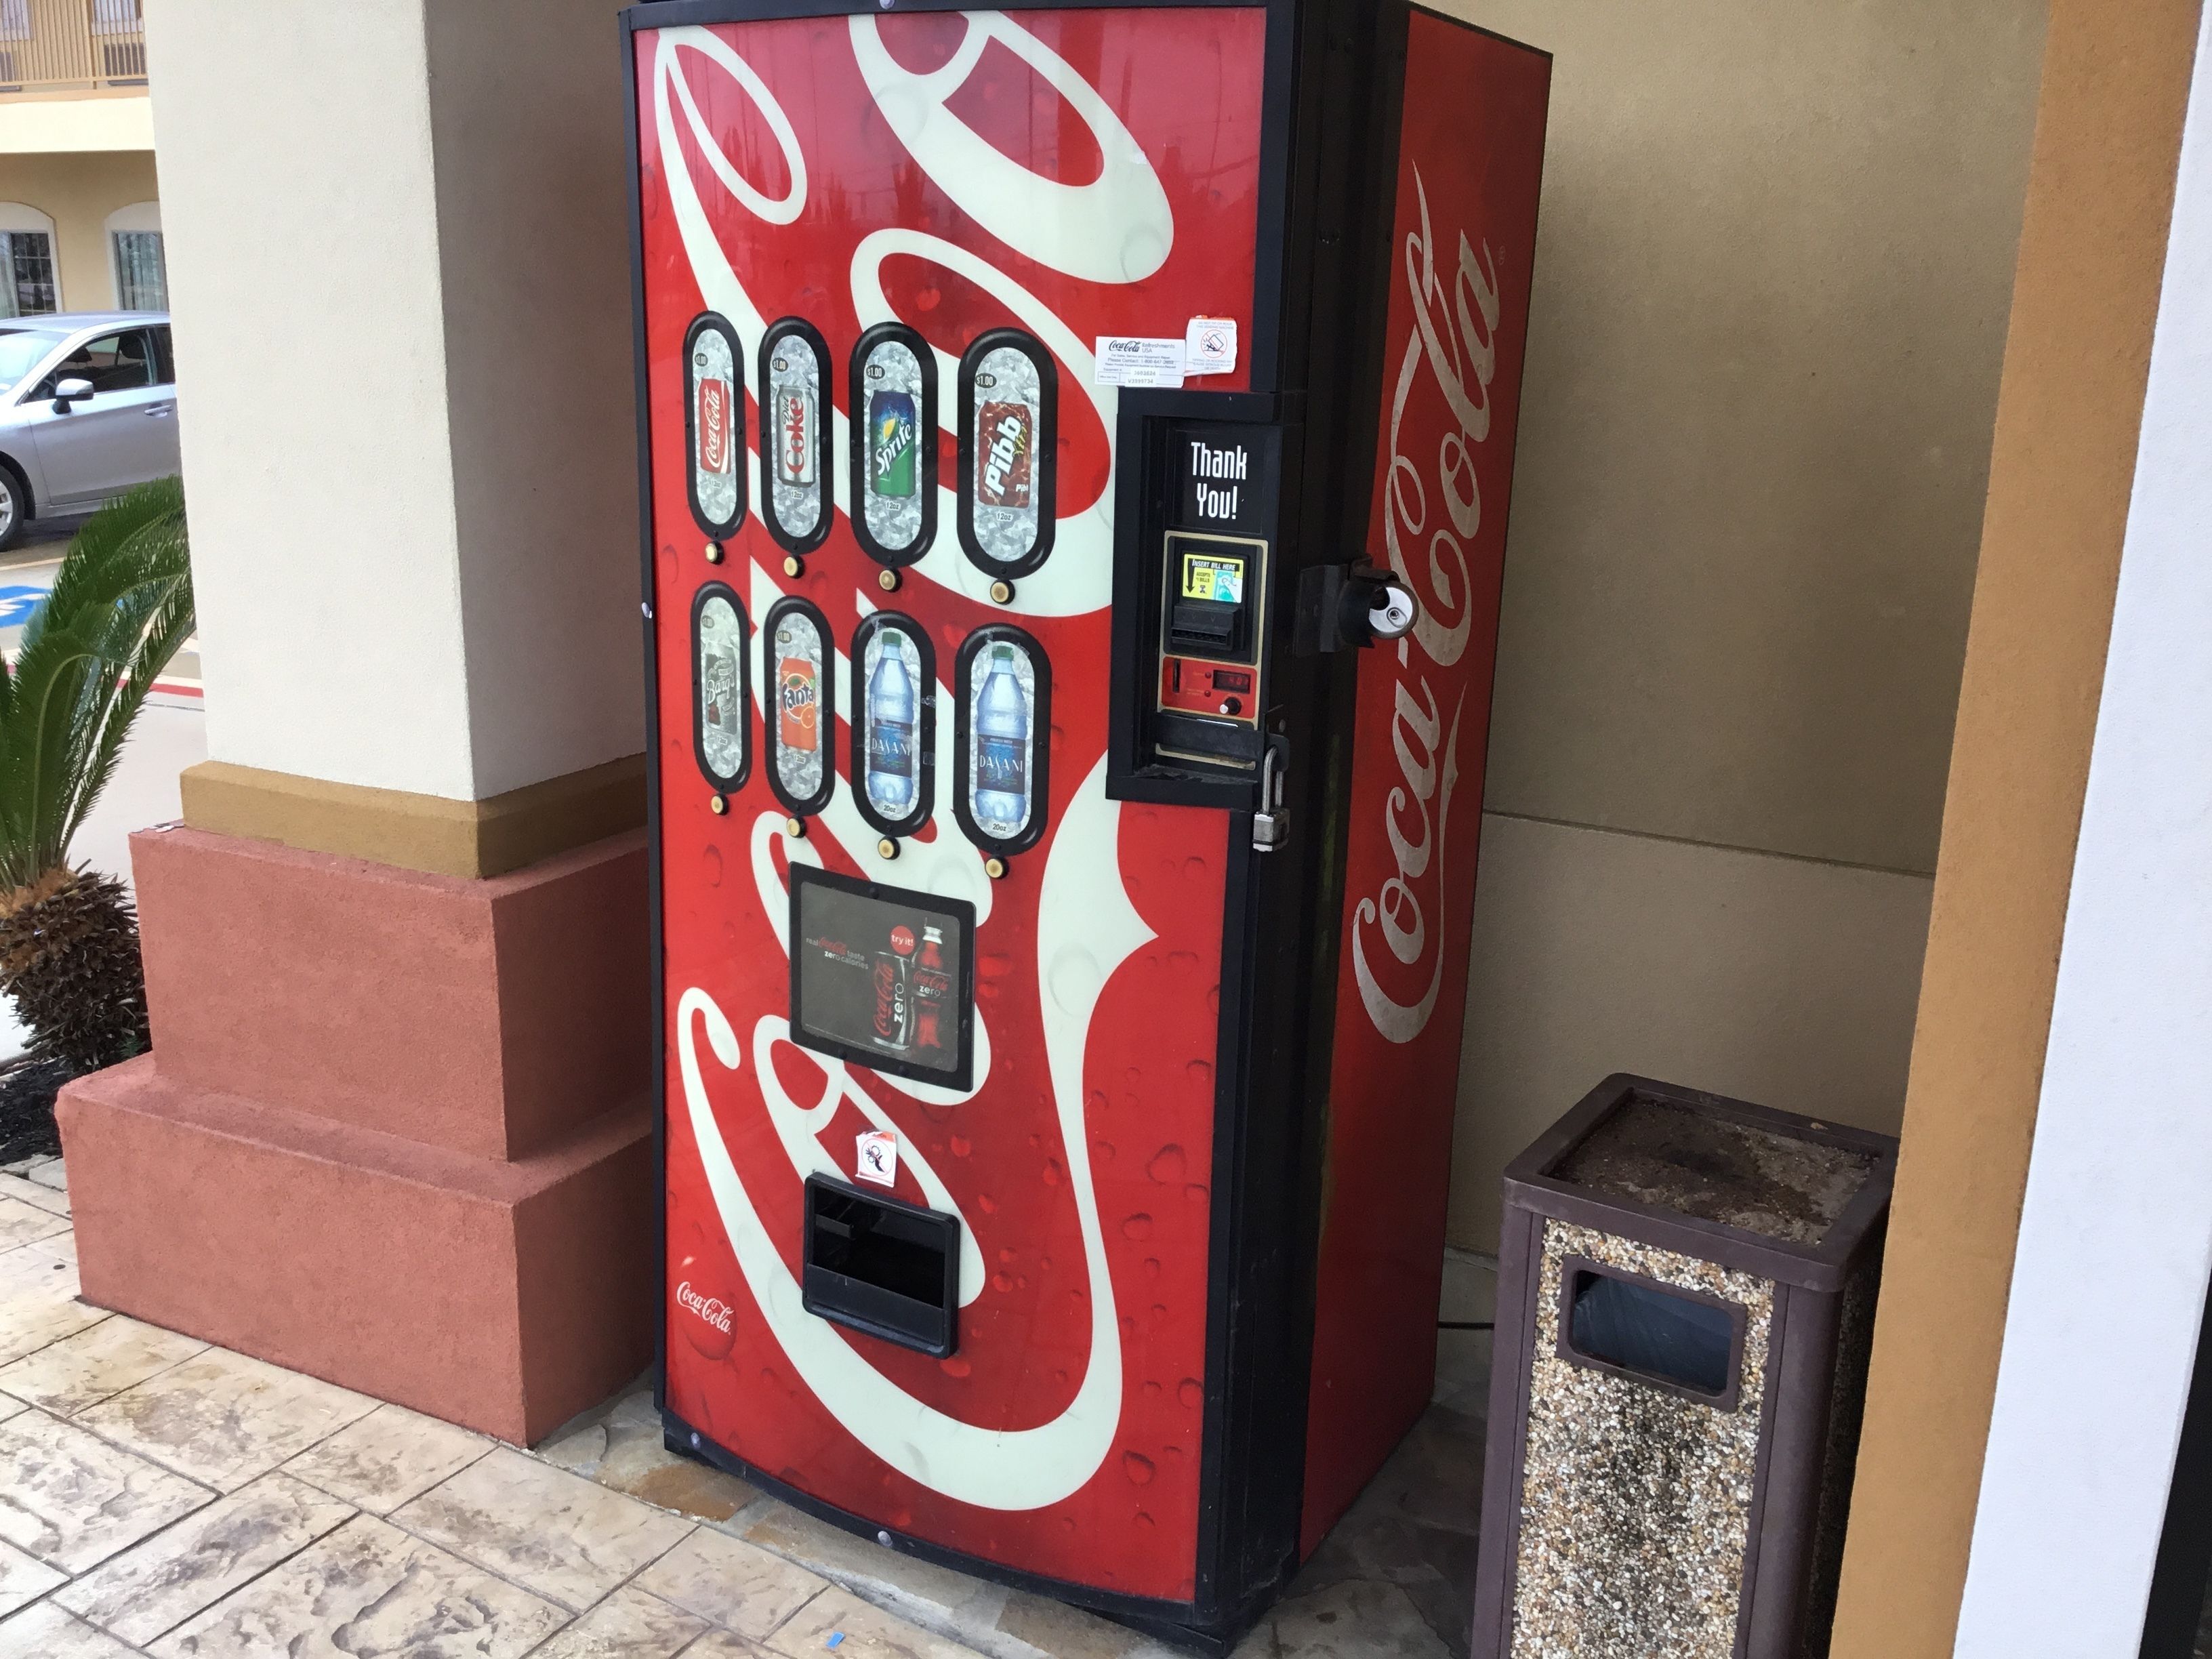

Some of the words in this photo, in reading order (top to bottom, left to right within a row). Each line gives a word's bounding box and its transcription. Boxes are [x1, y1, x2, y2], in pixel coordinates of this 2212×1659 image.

[1109, 340, 1141, 352] Coca-Cola
[773, 360, 786, 370] $1.00
[867, 367, 882, 377] $1.00
[977, 376, 994, 386] $1.00
[705, 386, 720, 468] Coca-Cola
[786, 397, 804, 473] Coke
[876, 423, 912, 476] Sprite
[985, 416, 1021, 496] Pibb
[1191, 441, 1248, 480] Thank
[1197, 483, 1238, 520] You!
[997, 512, 1012, 521] 12oz
[1192, 558, 1210, 568] INSERT
[1353, 159, 1500, 1044] Coca-Cola
[778, 632, 790, 642] $1.00
[782, 683, 814, 712] Fanta
[872, 737, 910, 756] DASANI
[980, 754, 1023, 773] DASANI
[883, 804, 897, 813] 20oz
[992, 823, 1007, 832] 20oz
[891, 935, 903, 945] try
[905, 939, 914, 947] it!
[824, 951, 840, 961] zero
[920, 985, 941, 997] zero
[894, 983, 904, 1024] zero
[677, 1282, 735, 1333] Coca-Cola
